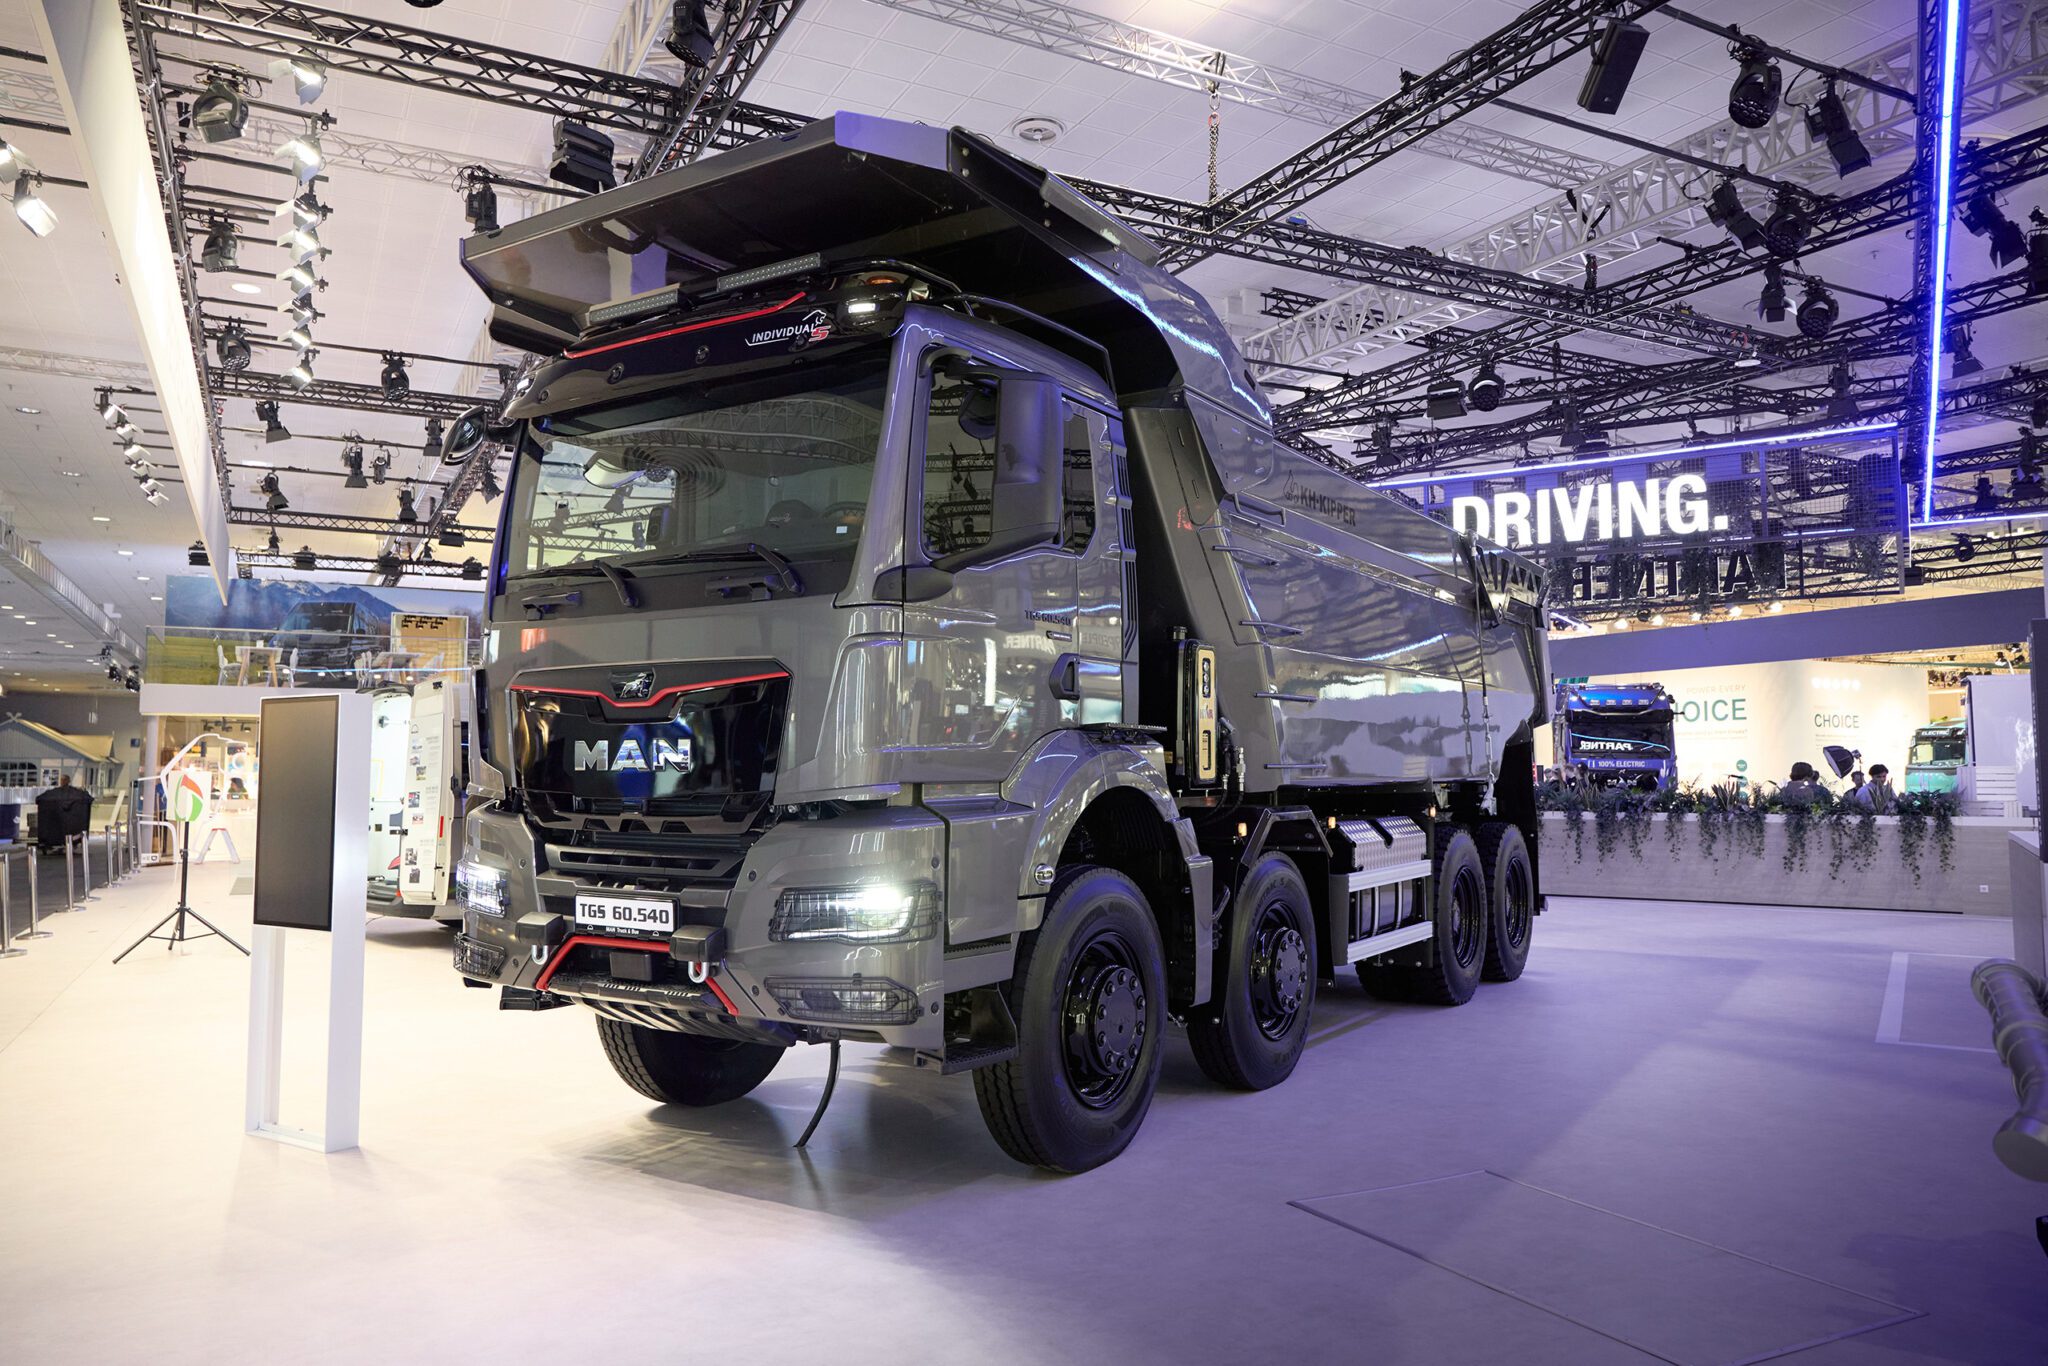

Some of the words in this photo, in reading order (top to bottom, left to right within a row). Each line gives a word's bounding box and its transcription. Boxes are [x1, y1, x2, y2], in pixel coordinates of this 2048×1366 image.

[752, 323, 816, 343] INDIVIDUAL
[1452, 473, 1730, 548] DRIVING.
[1814, 713, 1860, 729] CHOICE
[574, 738, 691, 773] MAN
[1598, 760, 1616, 768] 100%
[1615, 760, 1646, 768] ELECTRIC
[579, 903, 606, 919] TGS
[612, 906, 670, 924] 60.540
